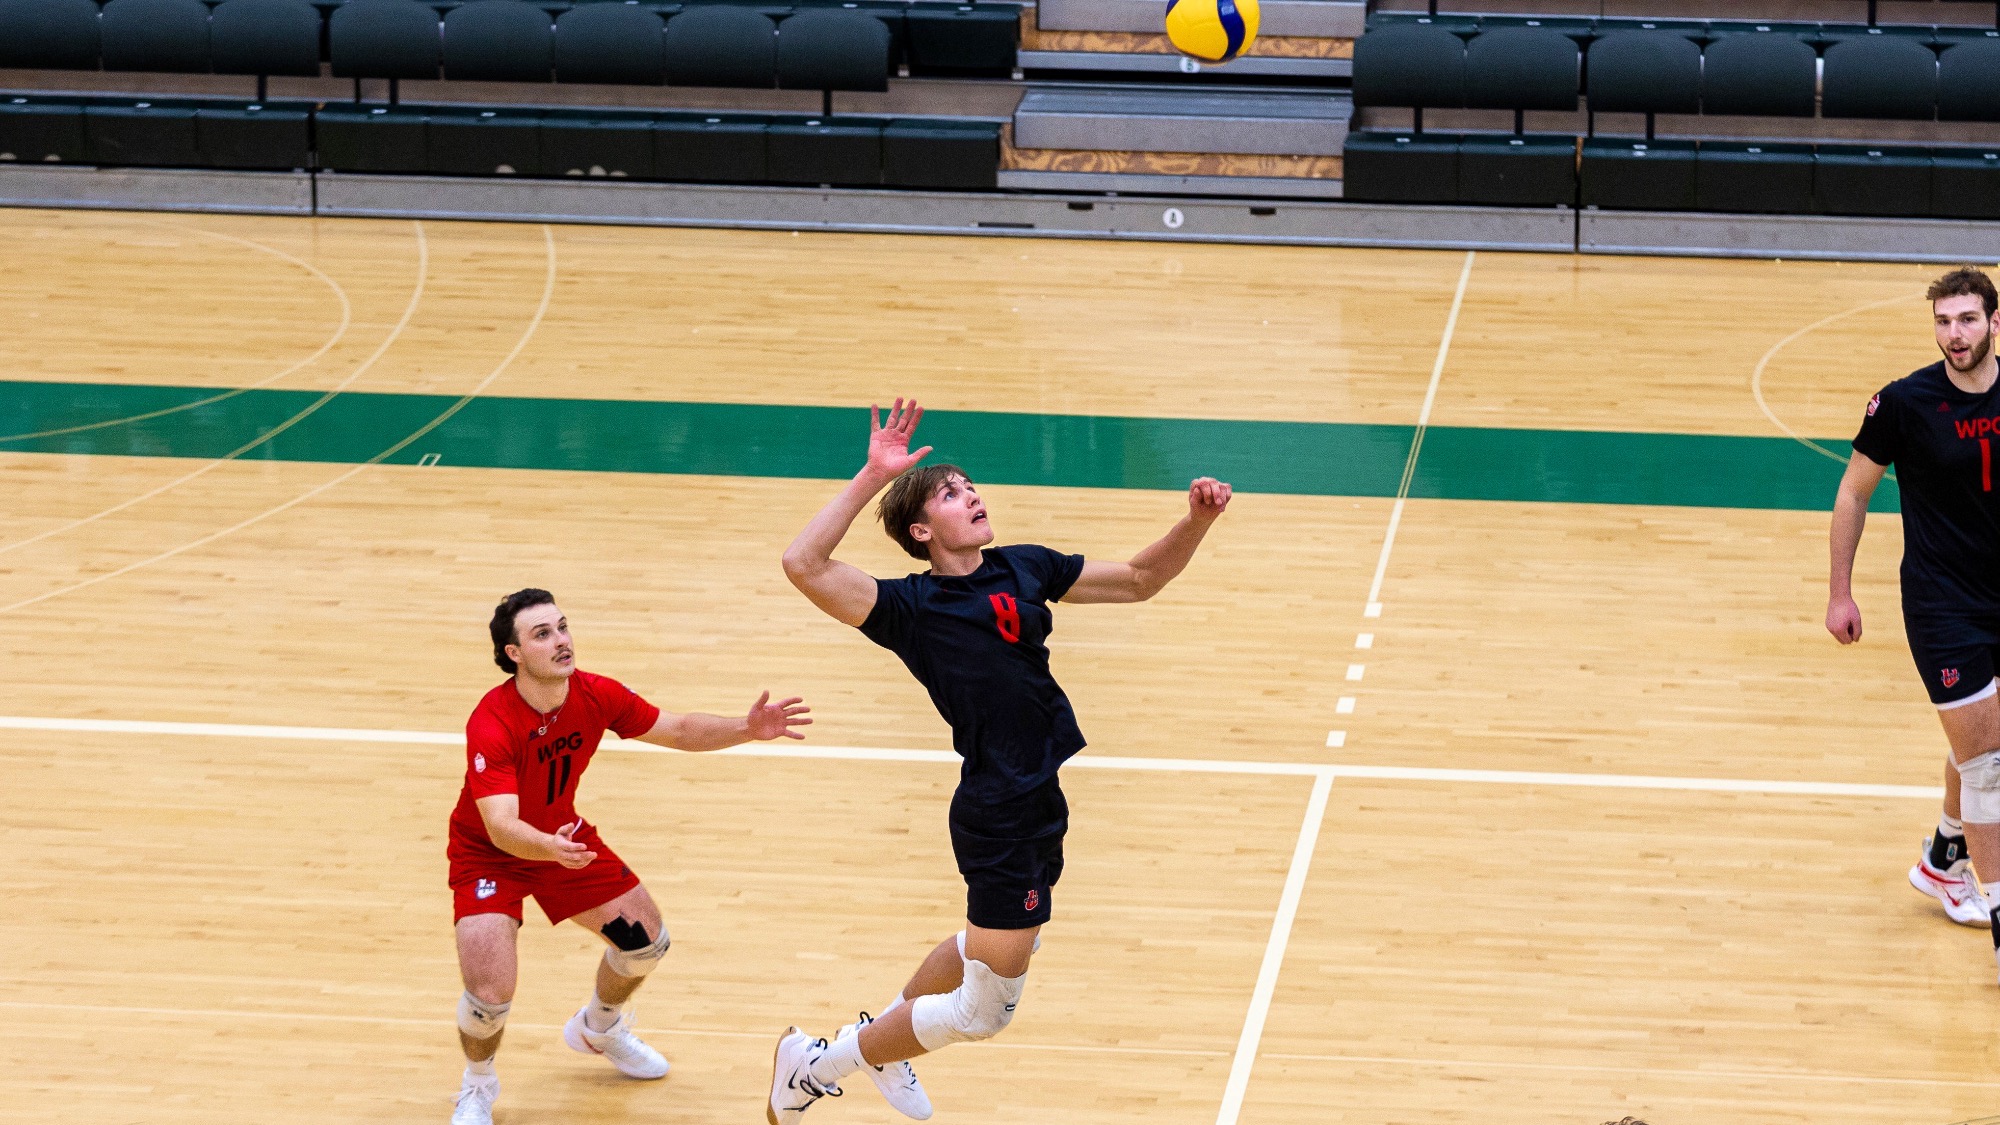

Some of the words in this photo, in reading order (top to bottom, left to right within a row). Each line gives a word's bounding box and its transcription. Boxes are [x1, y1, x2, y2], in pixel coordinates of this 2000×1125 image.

[1979, 438, 1991, 492] 1
[988, 592, 1021, 644] 8
[538, 732, 583, 763] WPG
[546, 754, 571, 806] 11
